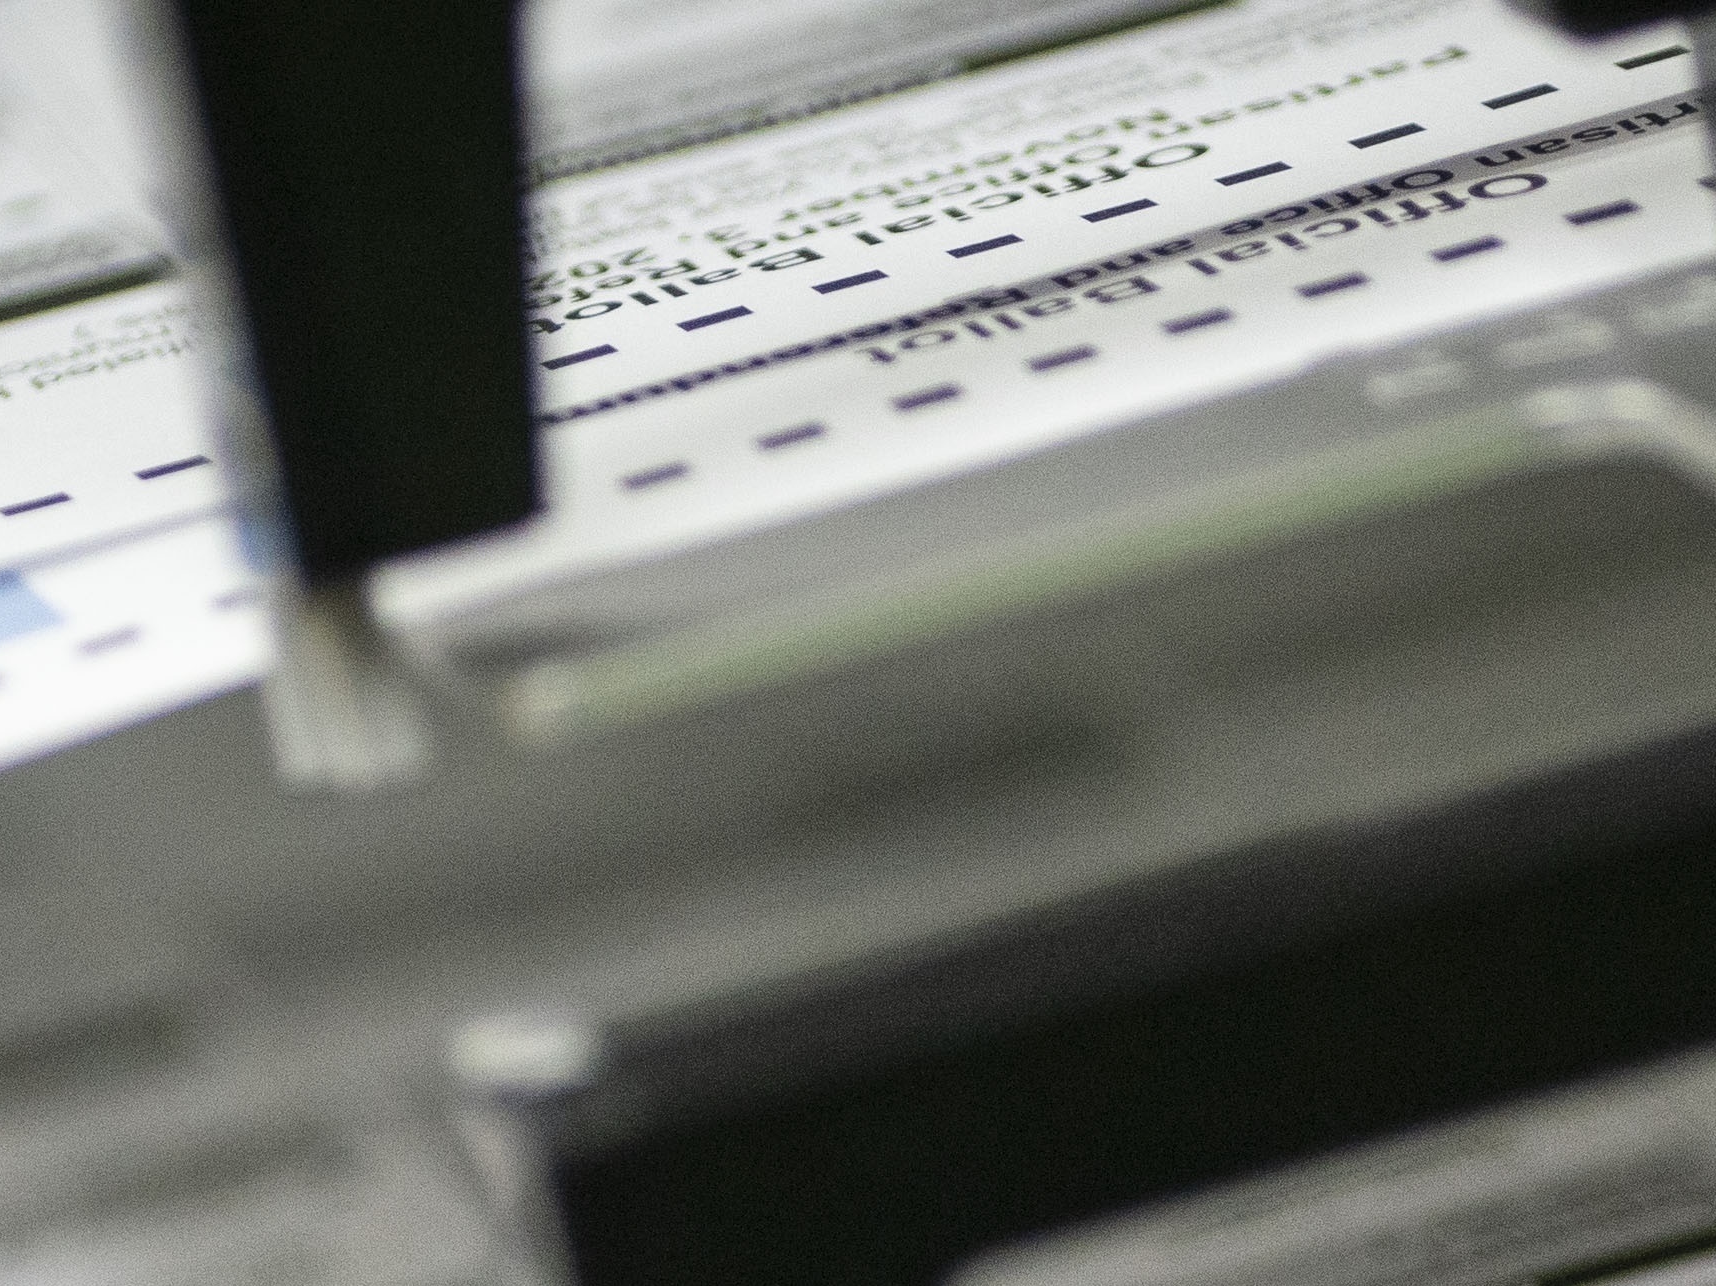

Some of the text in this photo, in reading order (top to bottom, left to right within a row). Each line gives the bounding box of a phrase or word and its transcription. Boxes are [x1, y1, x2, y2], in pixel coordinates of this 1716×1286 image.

[1217, 165, 1457, 236] Office
[527, 141, 1211, 336] Official Ballot
[722, 211, 864, 263] and
[856, 155, 1550, 367] Official Ballot
[1046, 235, 1198, 292] and
